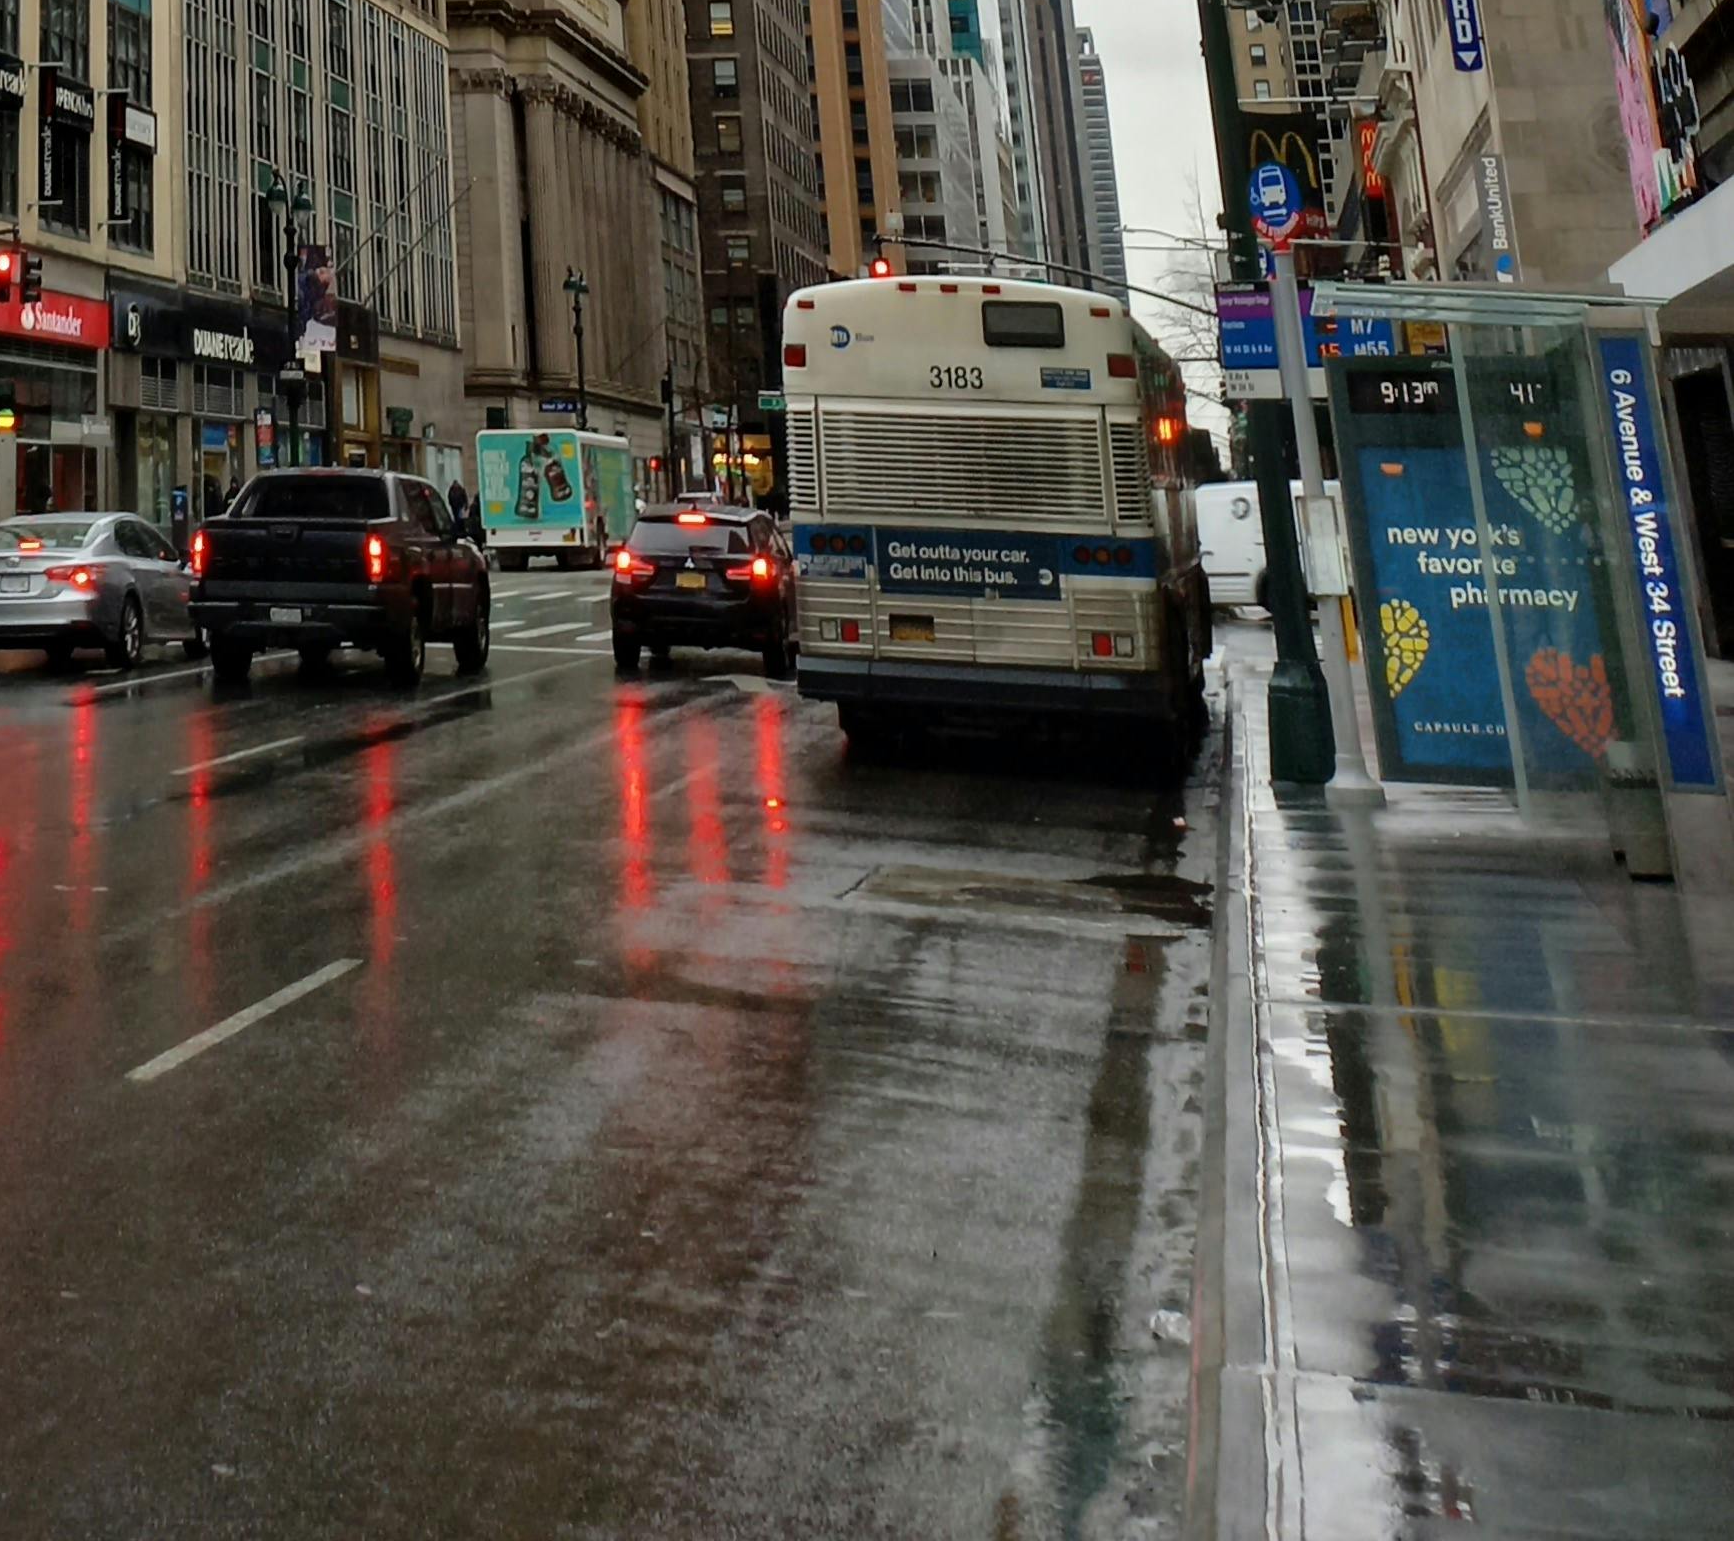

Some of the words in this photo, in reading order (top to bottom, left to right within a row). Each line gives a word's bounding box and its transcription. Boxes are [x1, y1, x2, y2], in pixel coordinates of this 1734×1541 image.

[1481, 155, 1509, 250] BankUnited
[35, 301, 82, 337] Santander
[930, 366, 984, 389] 3183
[1610, 368, 1632, 385] 6
[1612, 390, 1644, 482] Avenue
[1630, 487, 1653, 506] &
[1387, 525, 1439, 545] new
[1445, 523, 1521, 550] yok's
[1633, 510, 1664, 578] West
[888, 541, 916, 559] Get
[919, 544, 959, 561] outta
[962, 549, 998, 564] your
[1000, 549, 1030, 563] car.
[1417, 551, 1516, 576] favorte
[889, 563, 918, 580] Get
[920, 565, 951, 582] into
[953, 566, 982, 584] this
[984, 567, 1018, 585] bus.
[1645, 580, 1669, 612] 34
[1652, 619, 1686, 698] Street
[1414, 721, 1506, 736] CAPSULE.CO
